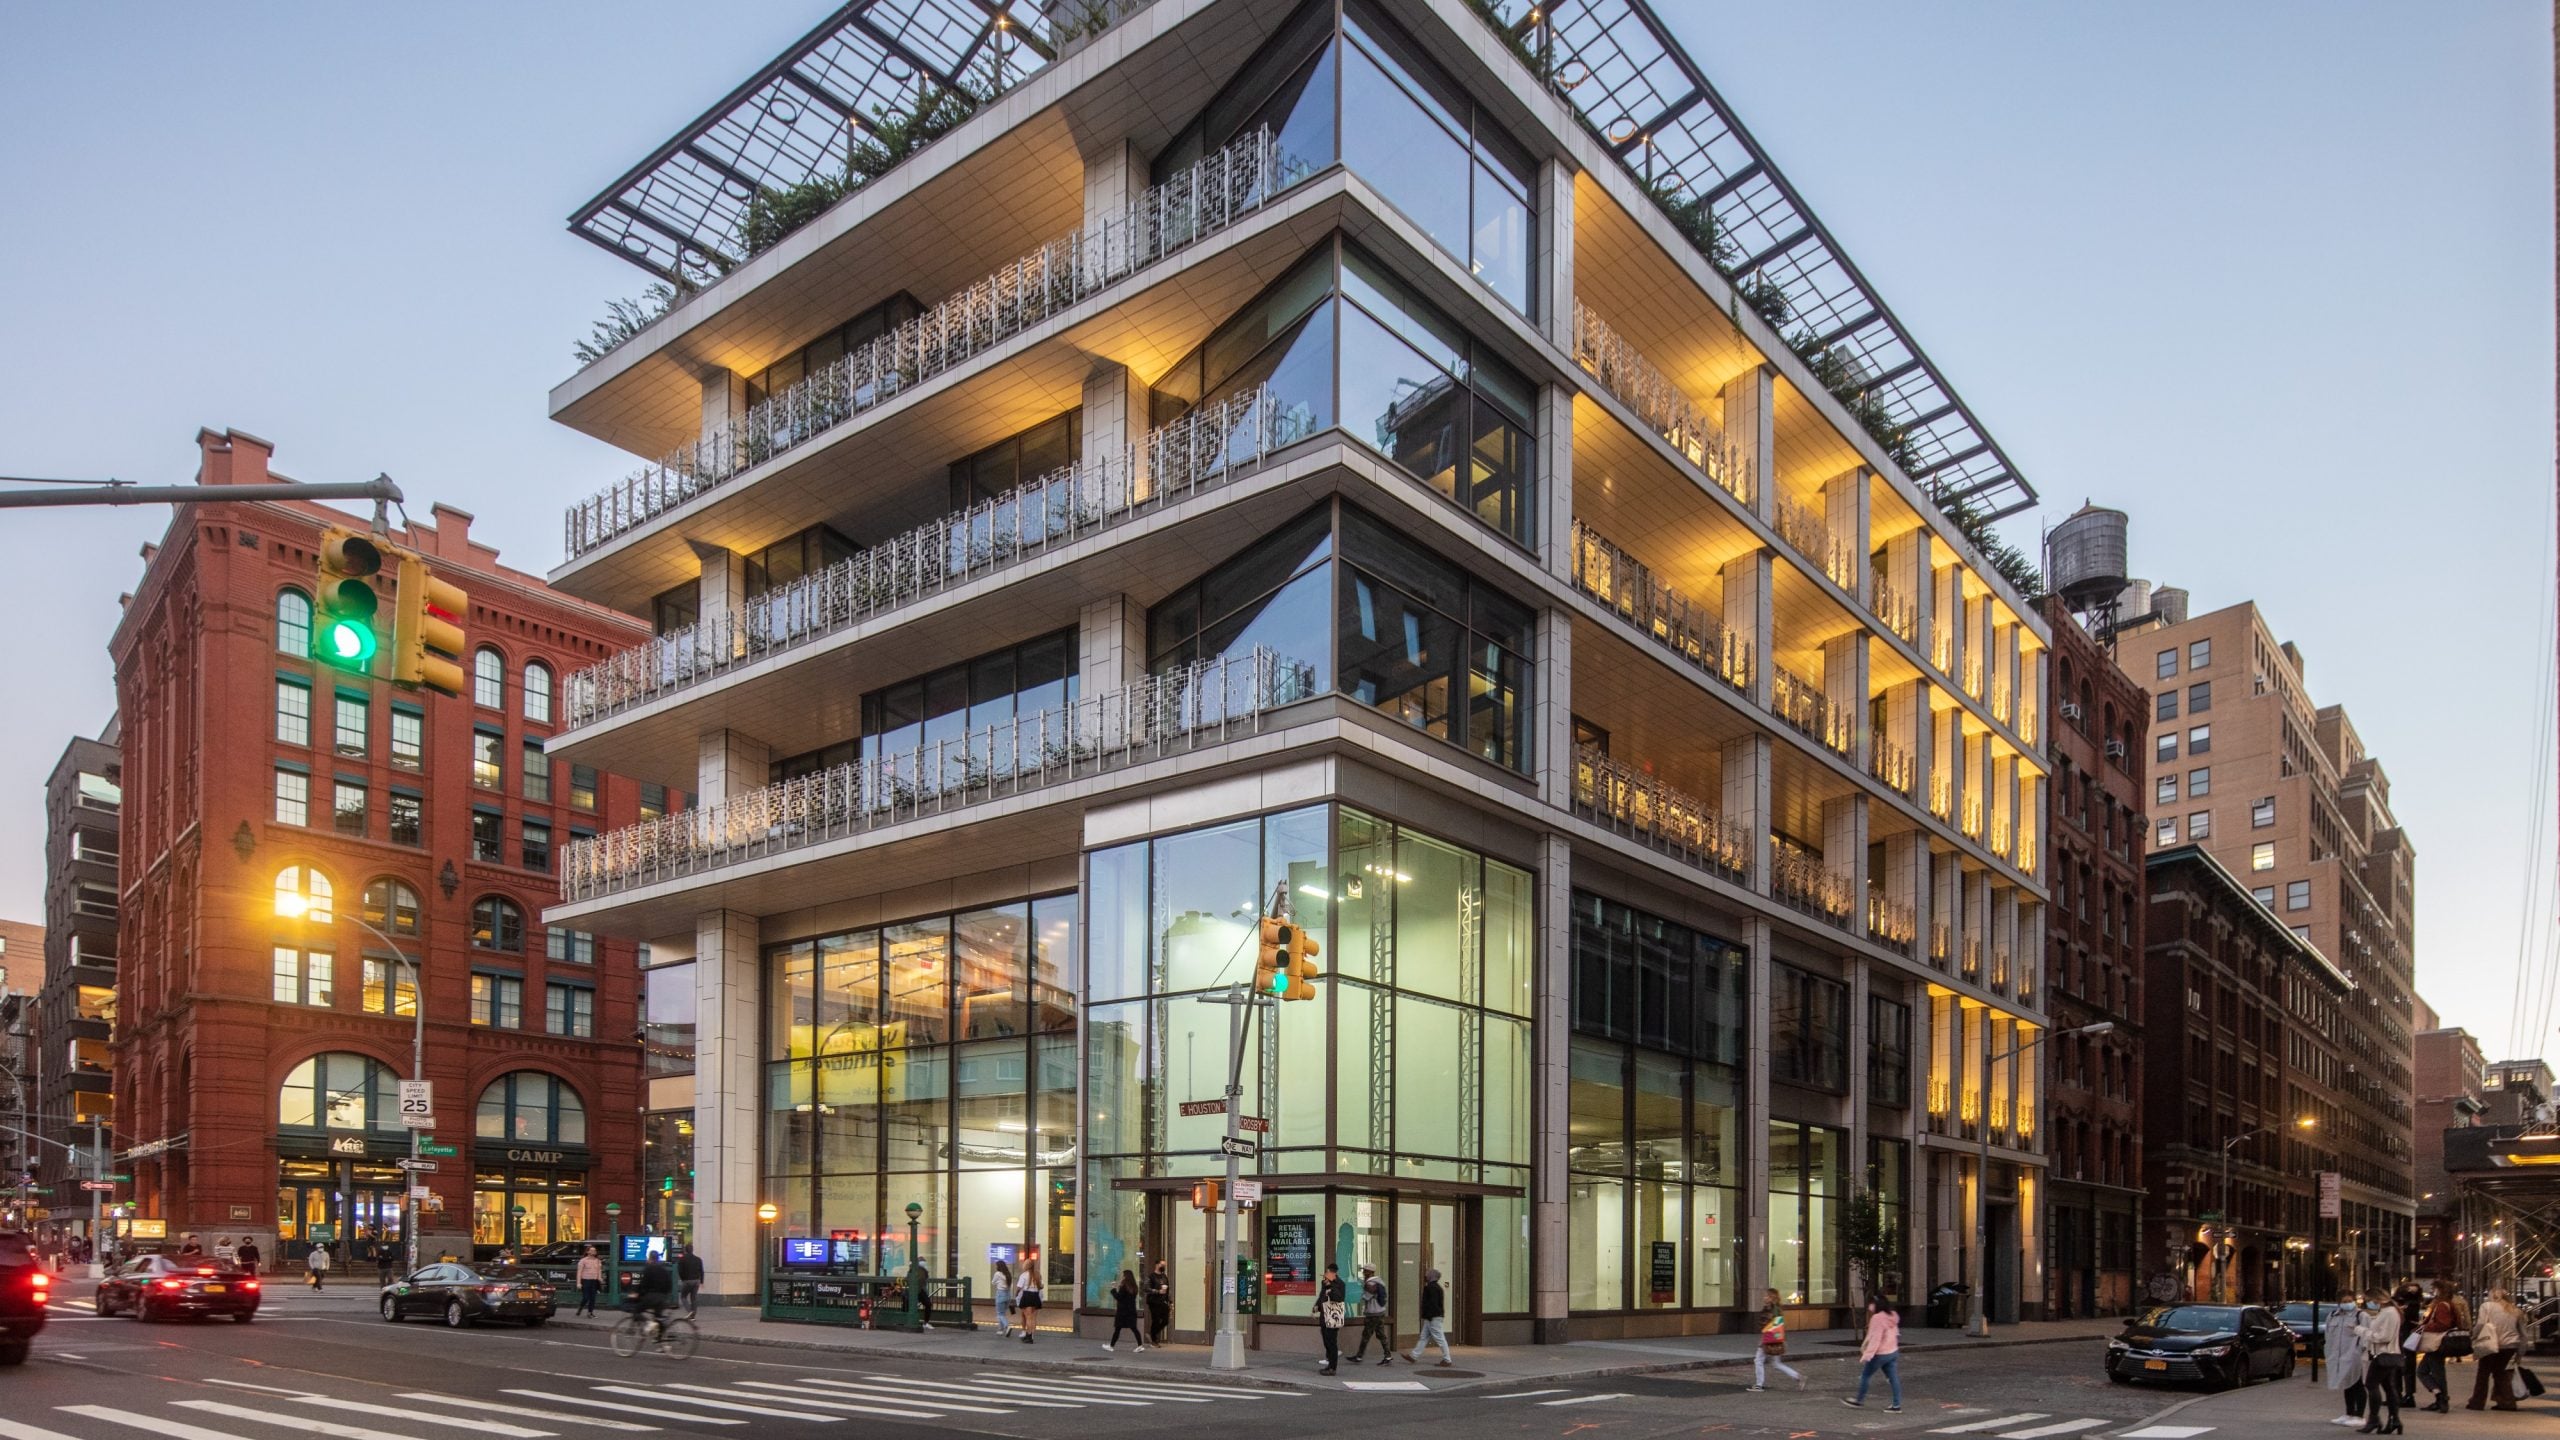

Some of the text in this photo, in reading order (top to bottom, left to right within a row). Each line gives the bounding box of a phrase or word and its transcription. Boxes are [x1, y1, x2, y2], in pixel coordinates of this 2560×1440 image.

[403, 1100, 427, 1112] 25
[1180, 1105, 1185, 1116] E
[1188, 1103, 1221, 1115] HOUSTON
[1240, 1118, 1263, 1130] CROSBY
[1226, 1142, 1252, 1154] ONE WAY
[507, 1149, 564, 1163] CAMP
[549, 1271, 567, 1280] Subway
[817, 1284, 842, 1294] Subway
